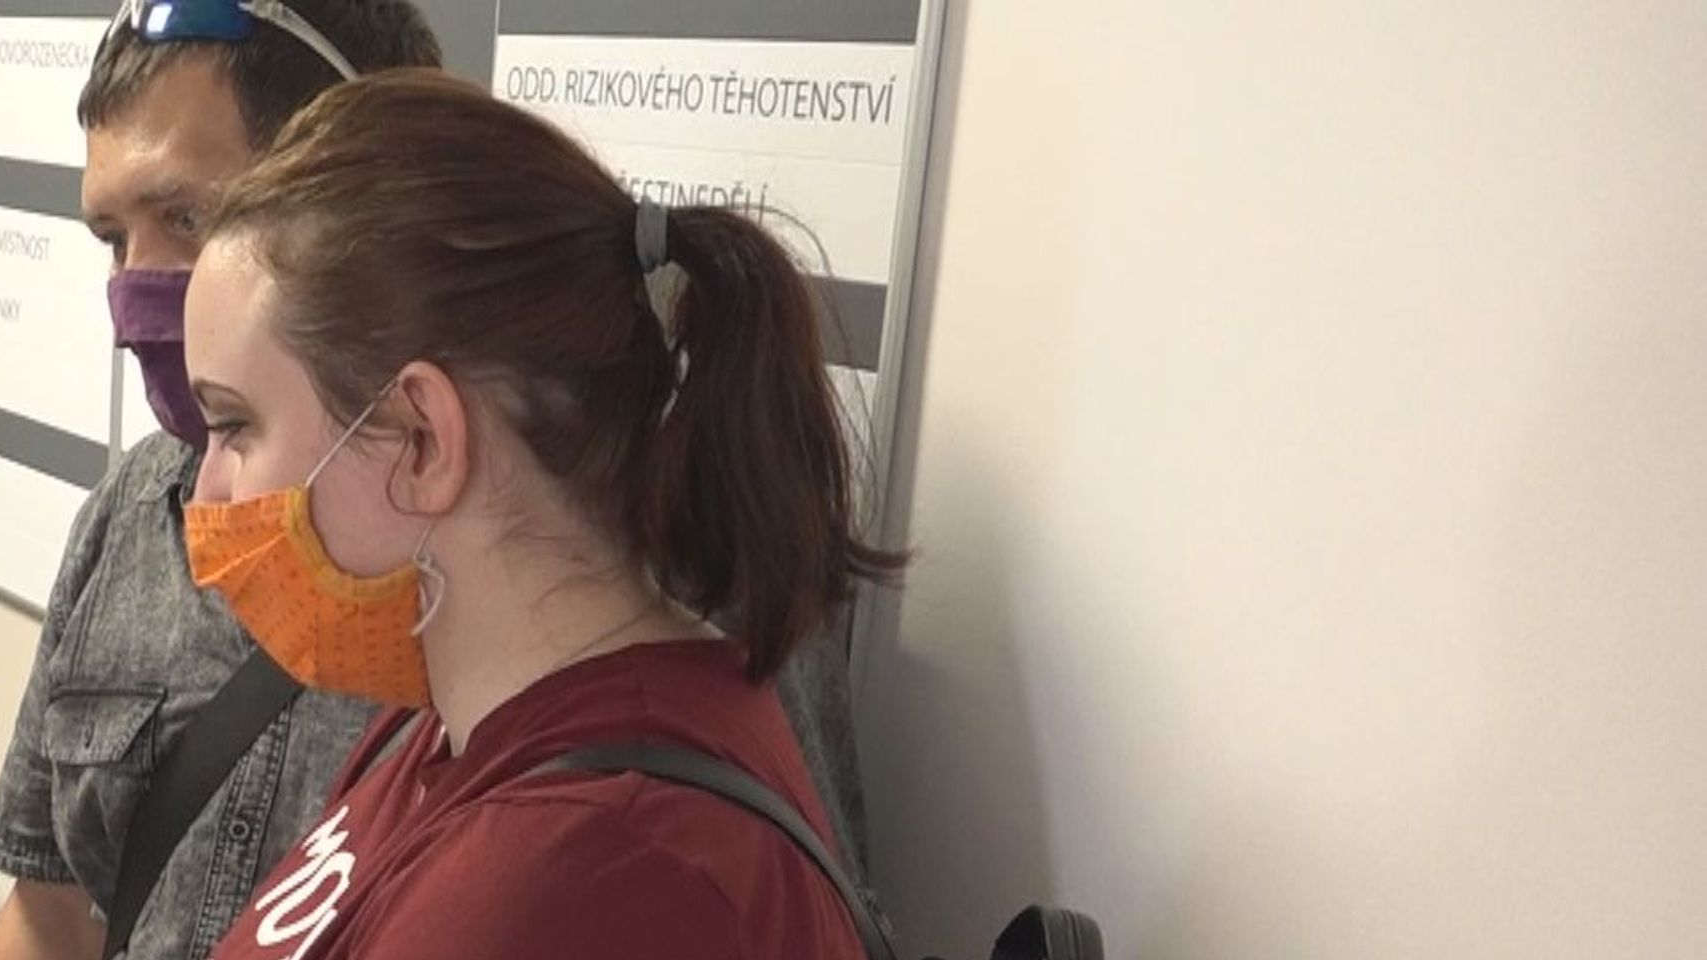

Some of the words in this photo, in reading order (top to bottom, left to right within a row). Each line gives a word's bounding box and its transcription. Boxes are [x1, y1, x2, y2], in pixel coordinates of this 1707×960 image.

[507, 67, 558, 102] ODD.
[565, 66, 704, 112] RIZIKOVÉHO
[710, 71, 897, 125] TĚHOTENSTVÍ
